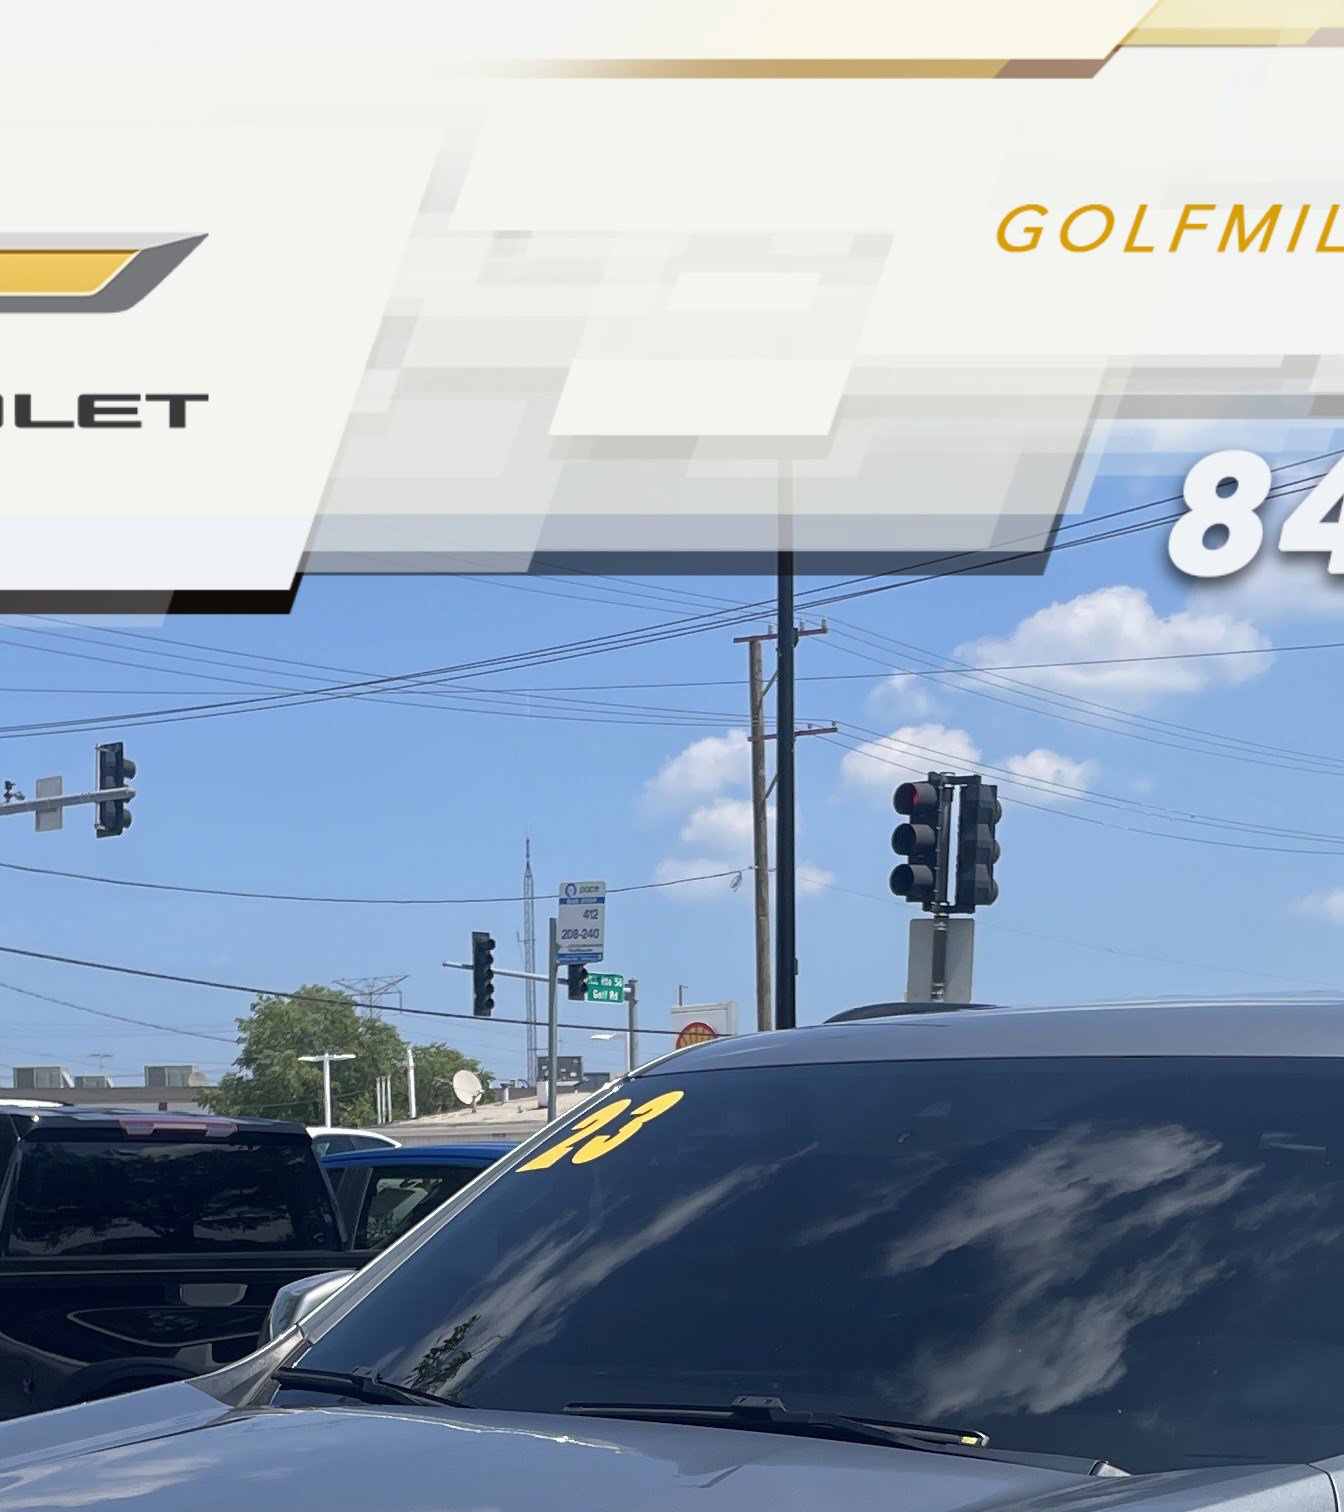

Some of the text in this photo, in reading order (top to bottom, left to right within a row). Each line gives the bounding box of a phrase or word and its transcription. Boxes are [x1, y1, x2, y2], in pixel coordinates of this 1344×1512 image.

[583, 909, 598, 919] 412
[592, 988, 608, 1000] Golf
[515, 1090, 685, 1174] 23
